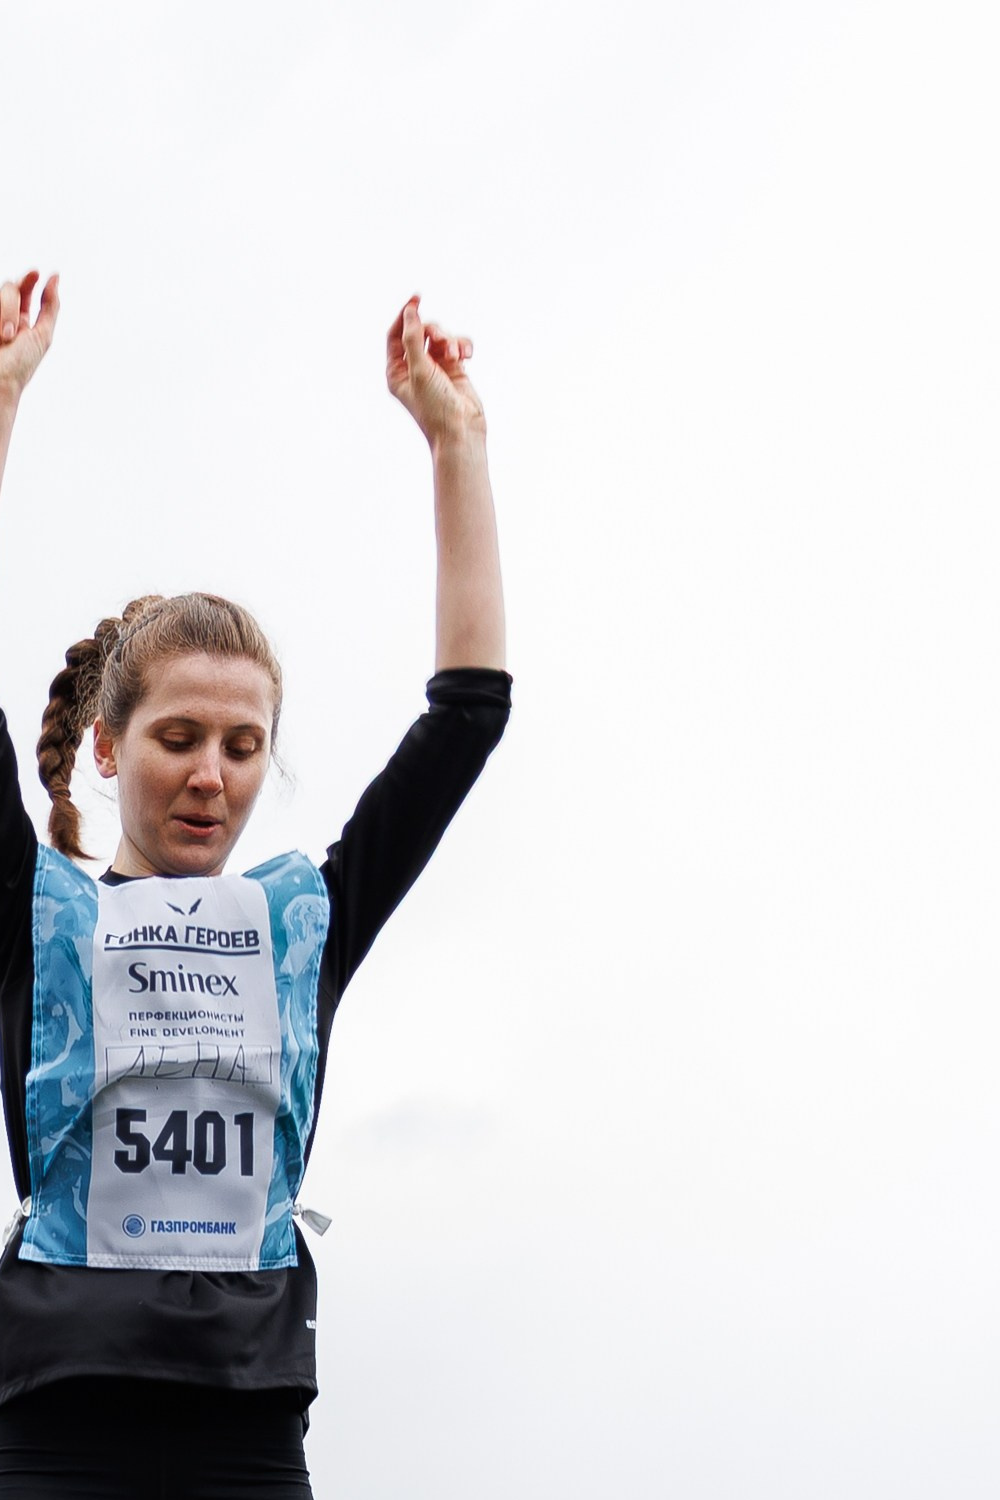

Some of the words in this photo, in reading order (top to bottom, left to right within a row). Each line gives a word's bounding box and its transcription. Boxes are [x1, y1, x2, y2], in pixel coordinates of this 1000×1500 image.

[104, 925, 178, 945] ГОНКА
[185, 926, 260, 949] ГЕРОЕВ
[128, 961, 240, 997] Sminex
[128, 1009, 245, 1023] ПЕРФЕКЦИОНИСТЫ
[130, 1027, 158, 1038] FINE
[162, 1025, 246, 1038] DEVELOPMENT
[116, 1040, 249, 1086] ЛЕНА
[114, 1107, 255, 1177] 5401
[150, 1219, 237, 1235] ГАЗПРОМБАНК
